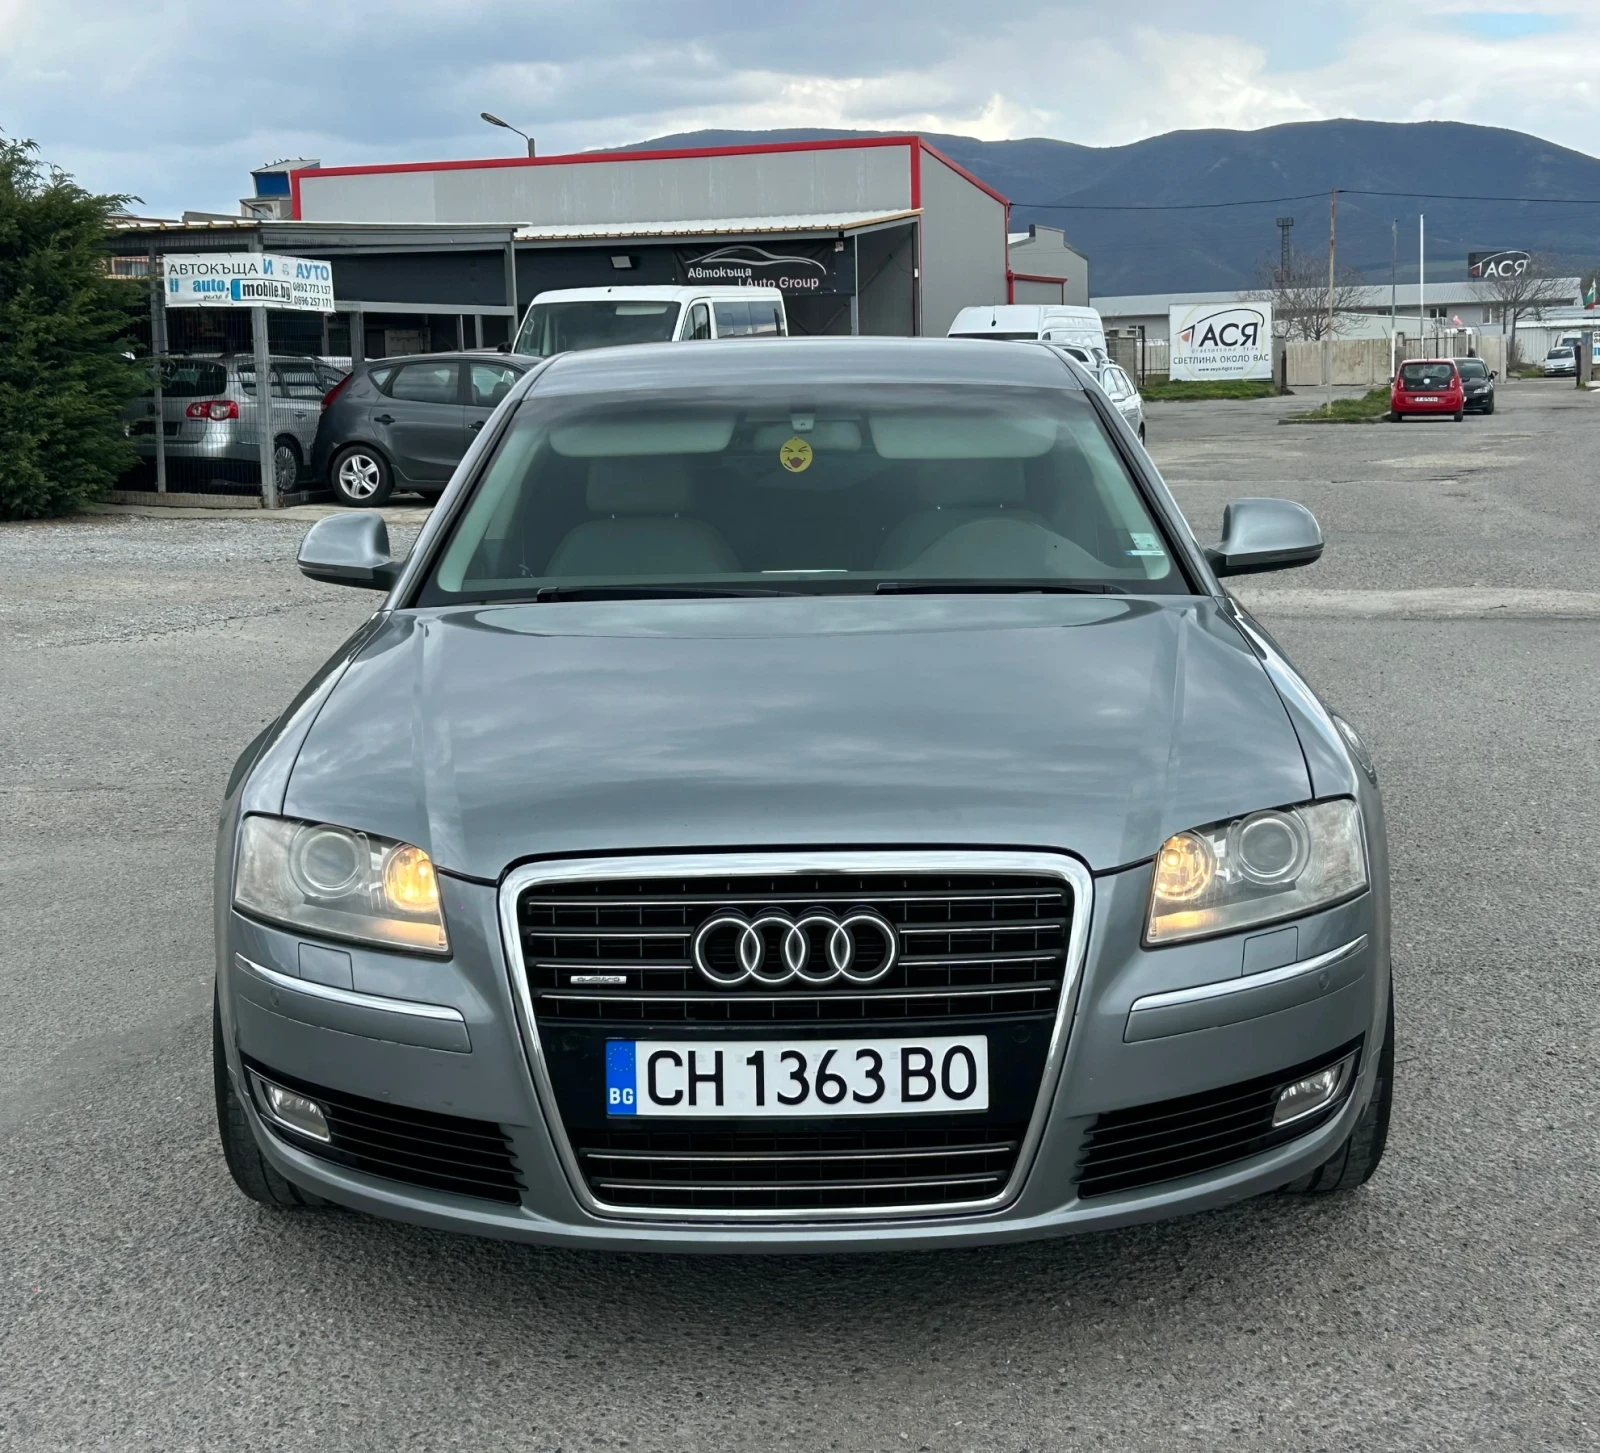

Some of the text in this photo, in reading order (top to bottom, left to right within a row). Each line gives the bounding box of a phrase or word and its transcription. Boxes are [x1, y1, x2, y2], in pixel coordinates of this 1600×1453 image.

[168, 263, 258, 276] АВТОКЪЩА
[296, 262, 330, 281] АУТО
[688, 267, 752, 278] Автокъща
[1484, 260, 1527, 278] АСЯ
[242, 281, 290, 300] mobile.bg
[309, 283, 319, 293] 773
[746, 278, 776, 288] Auto
[779, 277, 819, 290] Group
[310, 297, 321, 306] 257
[322, 298, 332, 308] 171
[1198, 322, 1258, 347] АСЯ
[1173, 354, 1270, 364] СВЕТЛИНА ОКОЛО ВАС
[609, 1045, 978, 1106] BG CH 1363 BO
